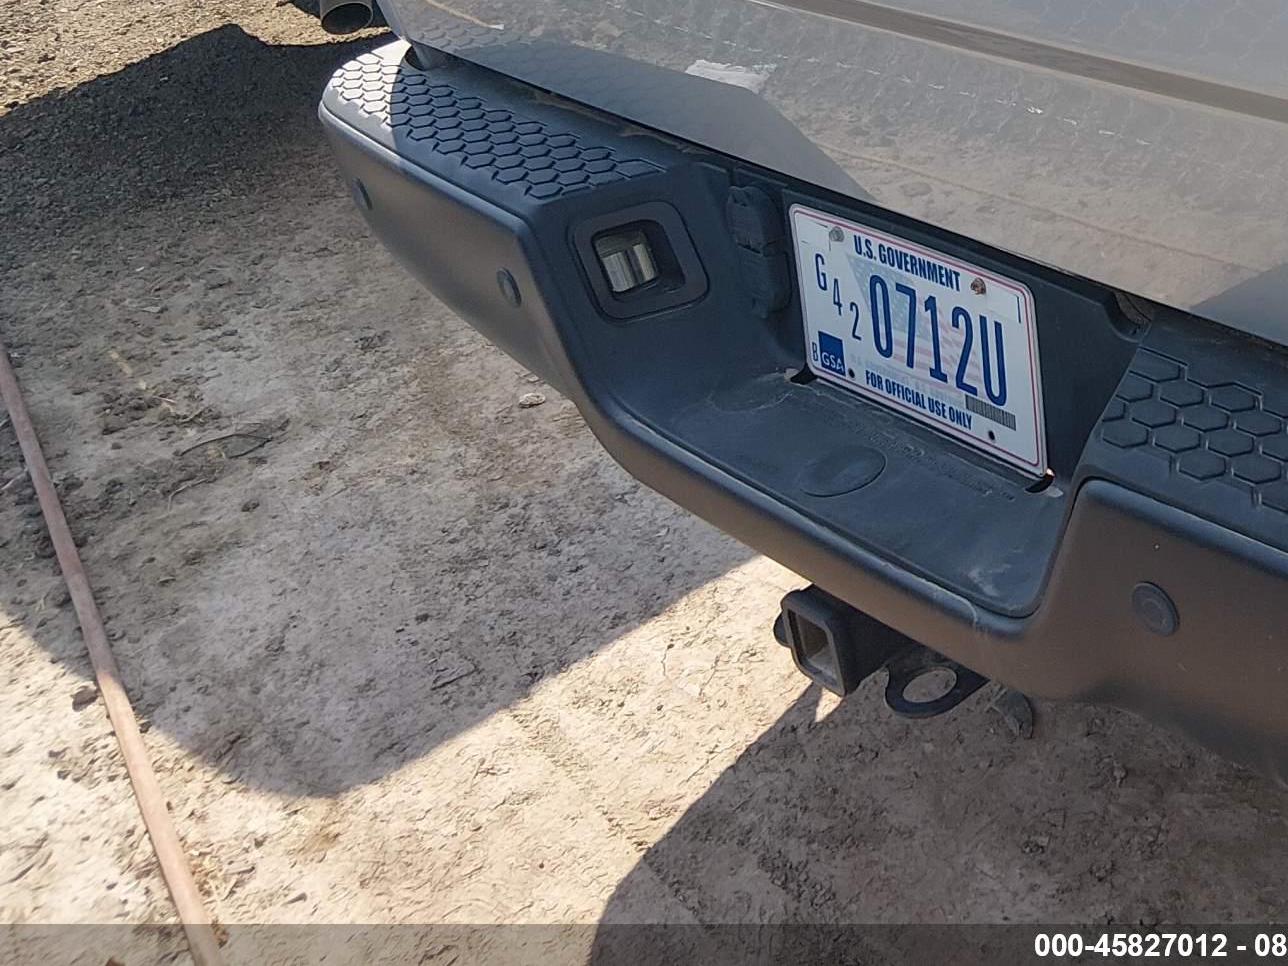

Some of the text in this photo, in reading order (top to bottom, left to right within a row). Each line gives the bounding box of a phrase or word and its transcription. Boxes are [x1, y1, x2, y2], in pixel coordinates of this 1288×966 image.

[853, 235, 961, 292] U.S. GOVERNMENT
[821, 352, 845, 372] GSA
[869, 274, 1008, 407] 0712U
[865, 370, 884, 391] FOR
[885, 378, 927, 409] OFFICIAL
[928, 397, 948, 419] USE
[949, 406, 973, 431] ONLY
